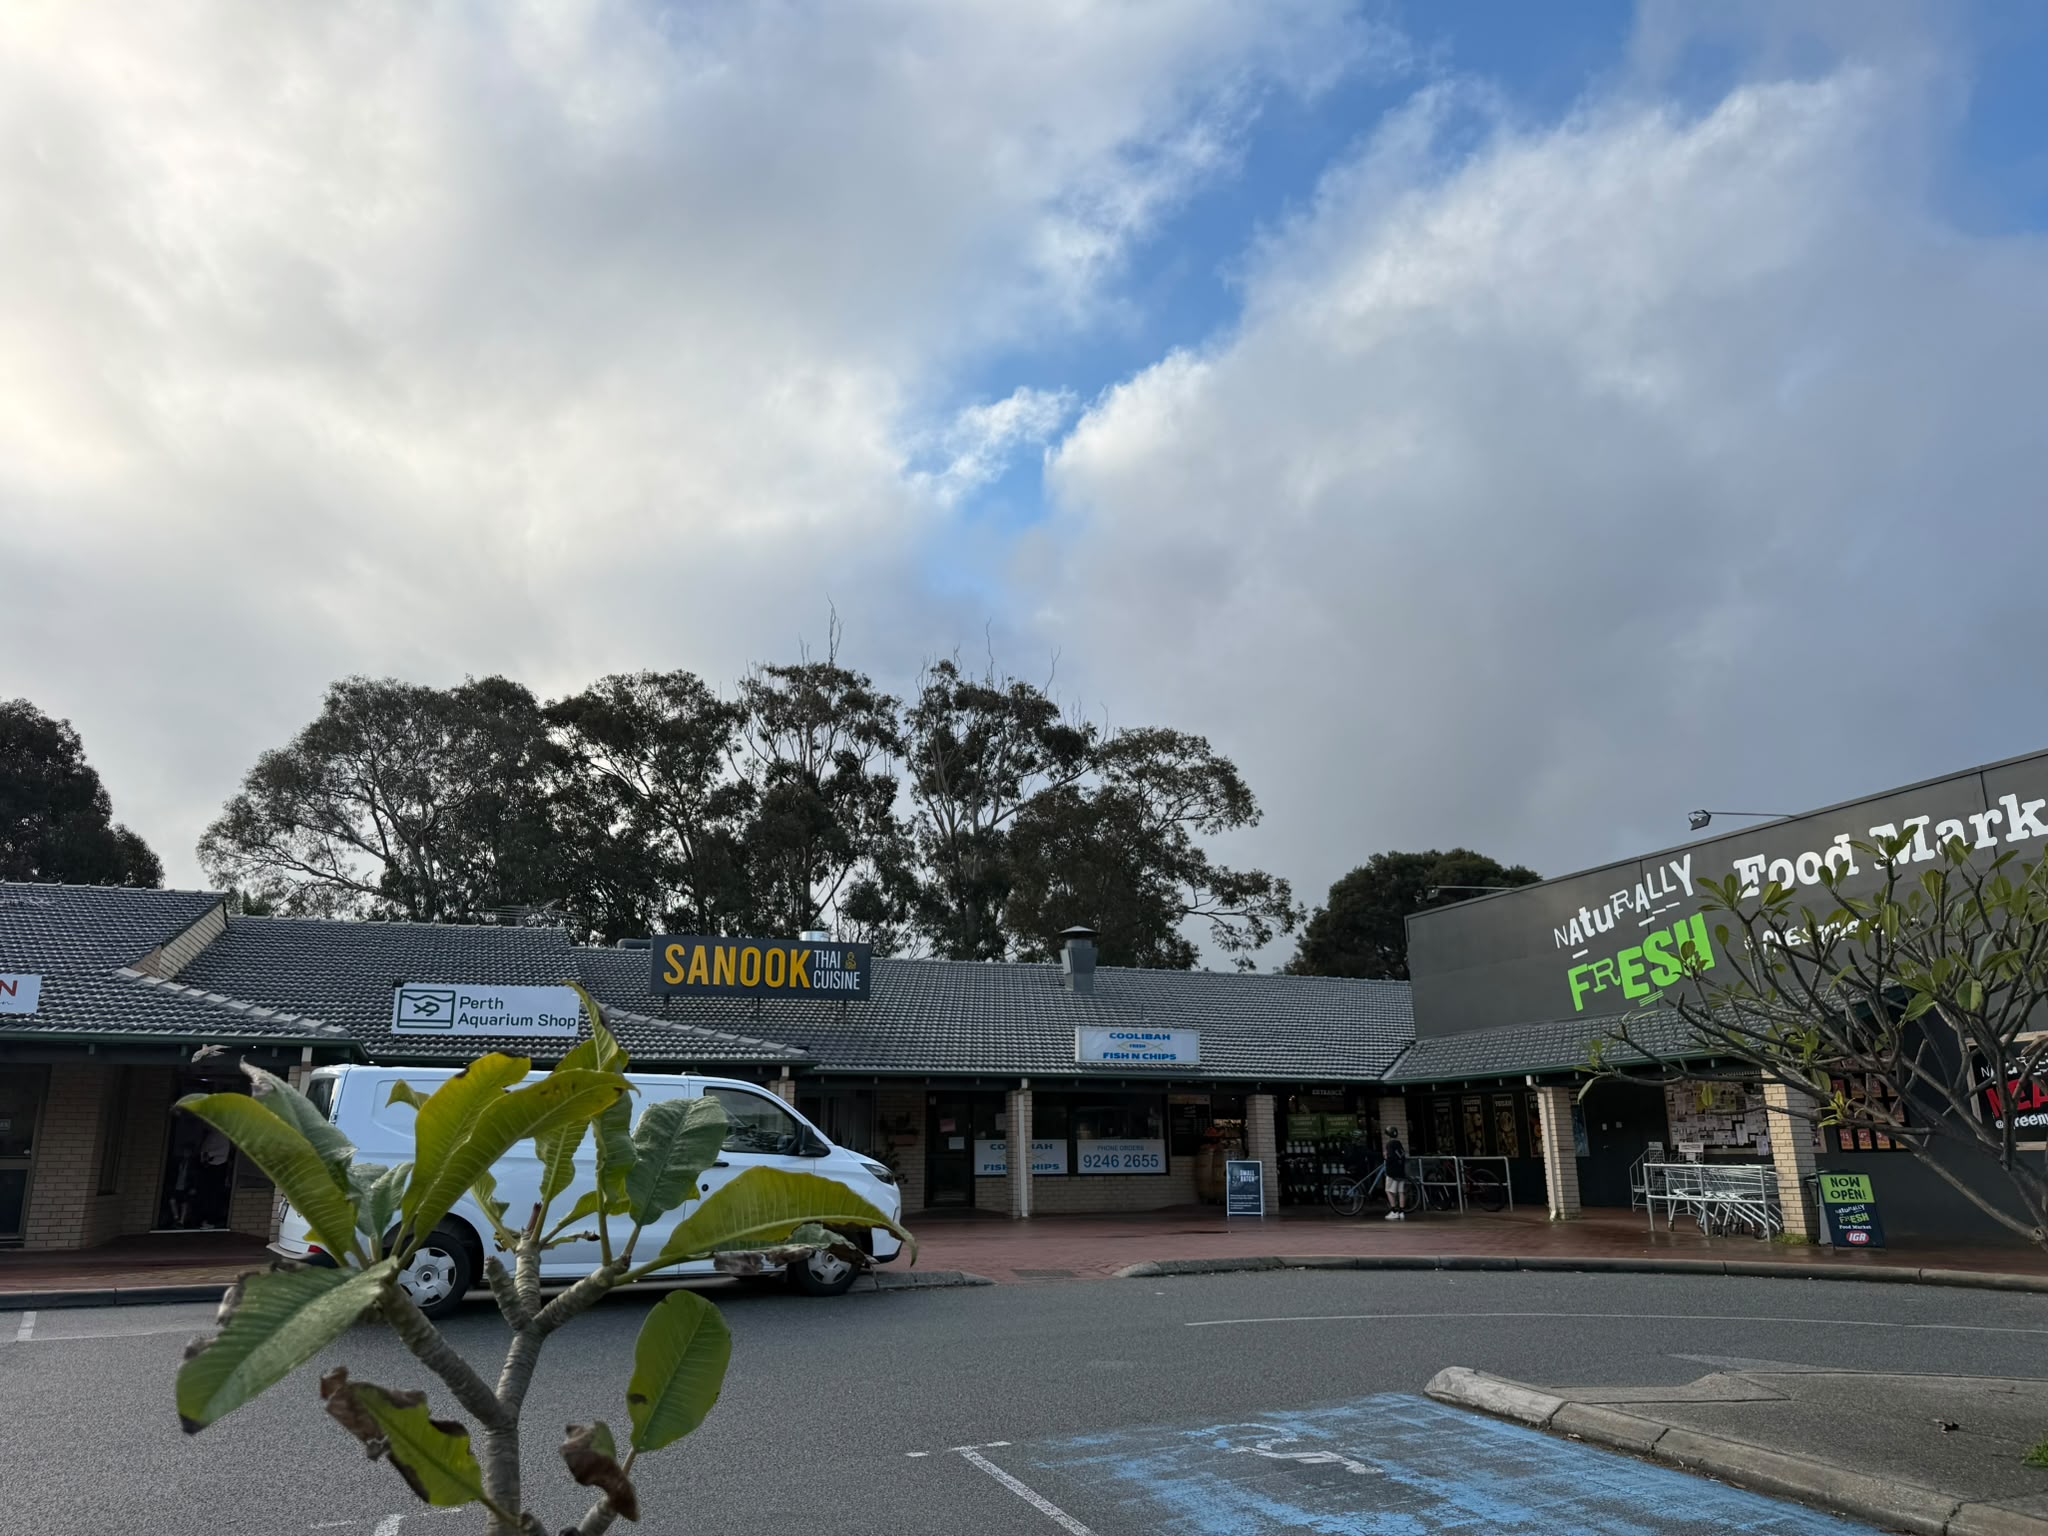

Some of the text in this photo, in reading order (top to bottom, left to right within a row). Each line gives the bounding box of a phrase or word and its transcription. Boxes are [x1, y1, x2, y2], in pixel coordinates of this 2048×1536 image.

[1733, 833, 1859, 899] Food
[663, 943, 811, 988] SANOOK
[813, 949, 841, 969] THAI
[1567, 912, 1716, 1012] FRESH
[812, 970, 860, 990] CUISINE
[459, 996, 504, 1010] Perth
[457, 1012, 577, 1030] Aquarium Shop
[1109, 1032, 1171, 1040] COOLIBAH
[1103, 1052, 1129, 1060] FISH
[1032, 1163, 1060, 1171] HIPS
[1083, 1154, 1159, 1168] 9246 2655
[1830, 1176, 1860, 1188] NOW
[1830, 1188, 1867, 1201] OPEN!
[1839, 1212, 1870, 1224] FRESH
[1849, 1232, 1867, 1242] IGA
